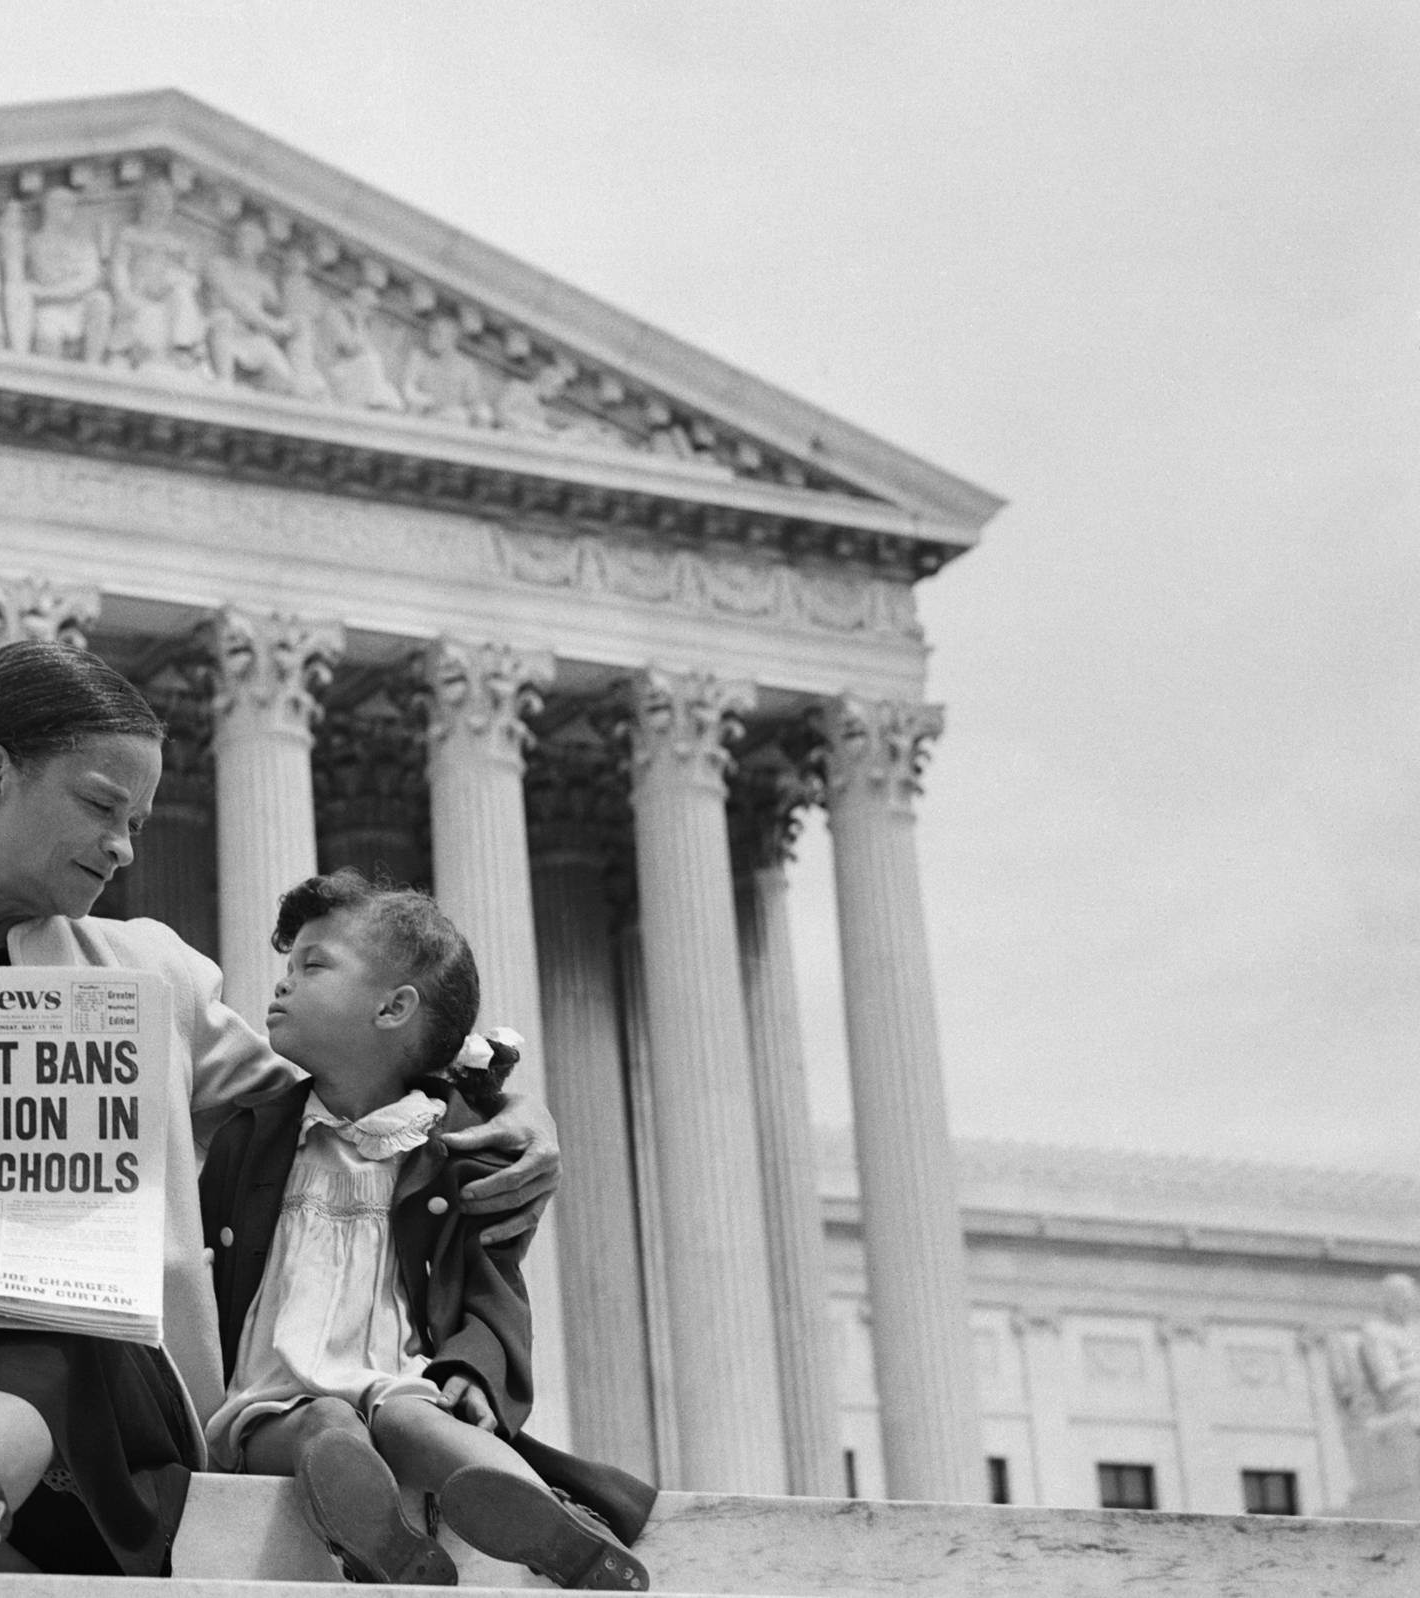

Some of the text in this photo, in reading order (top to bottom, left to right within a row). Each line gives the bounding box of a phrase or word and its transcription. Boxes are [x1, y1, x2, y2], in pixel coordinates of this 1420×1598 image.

[109, 1016, 135, 1025] Edition
[35, 1040, 139, 1085] BANS
[98, 1096, 139, 1140] IN
[3, 1272, 27, 1283] JOE
